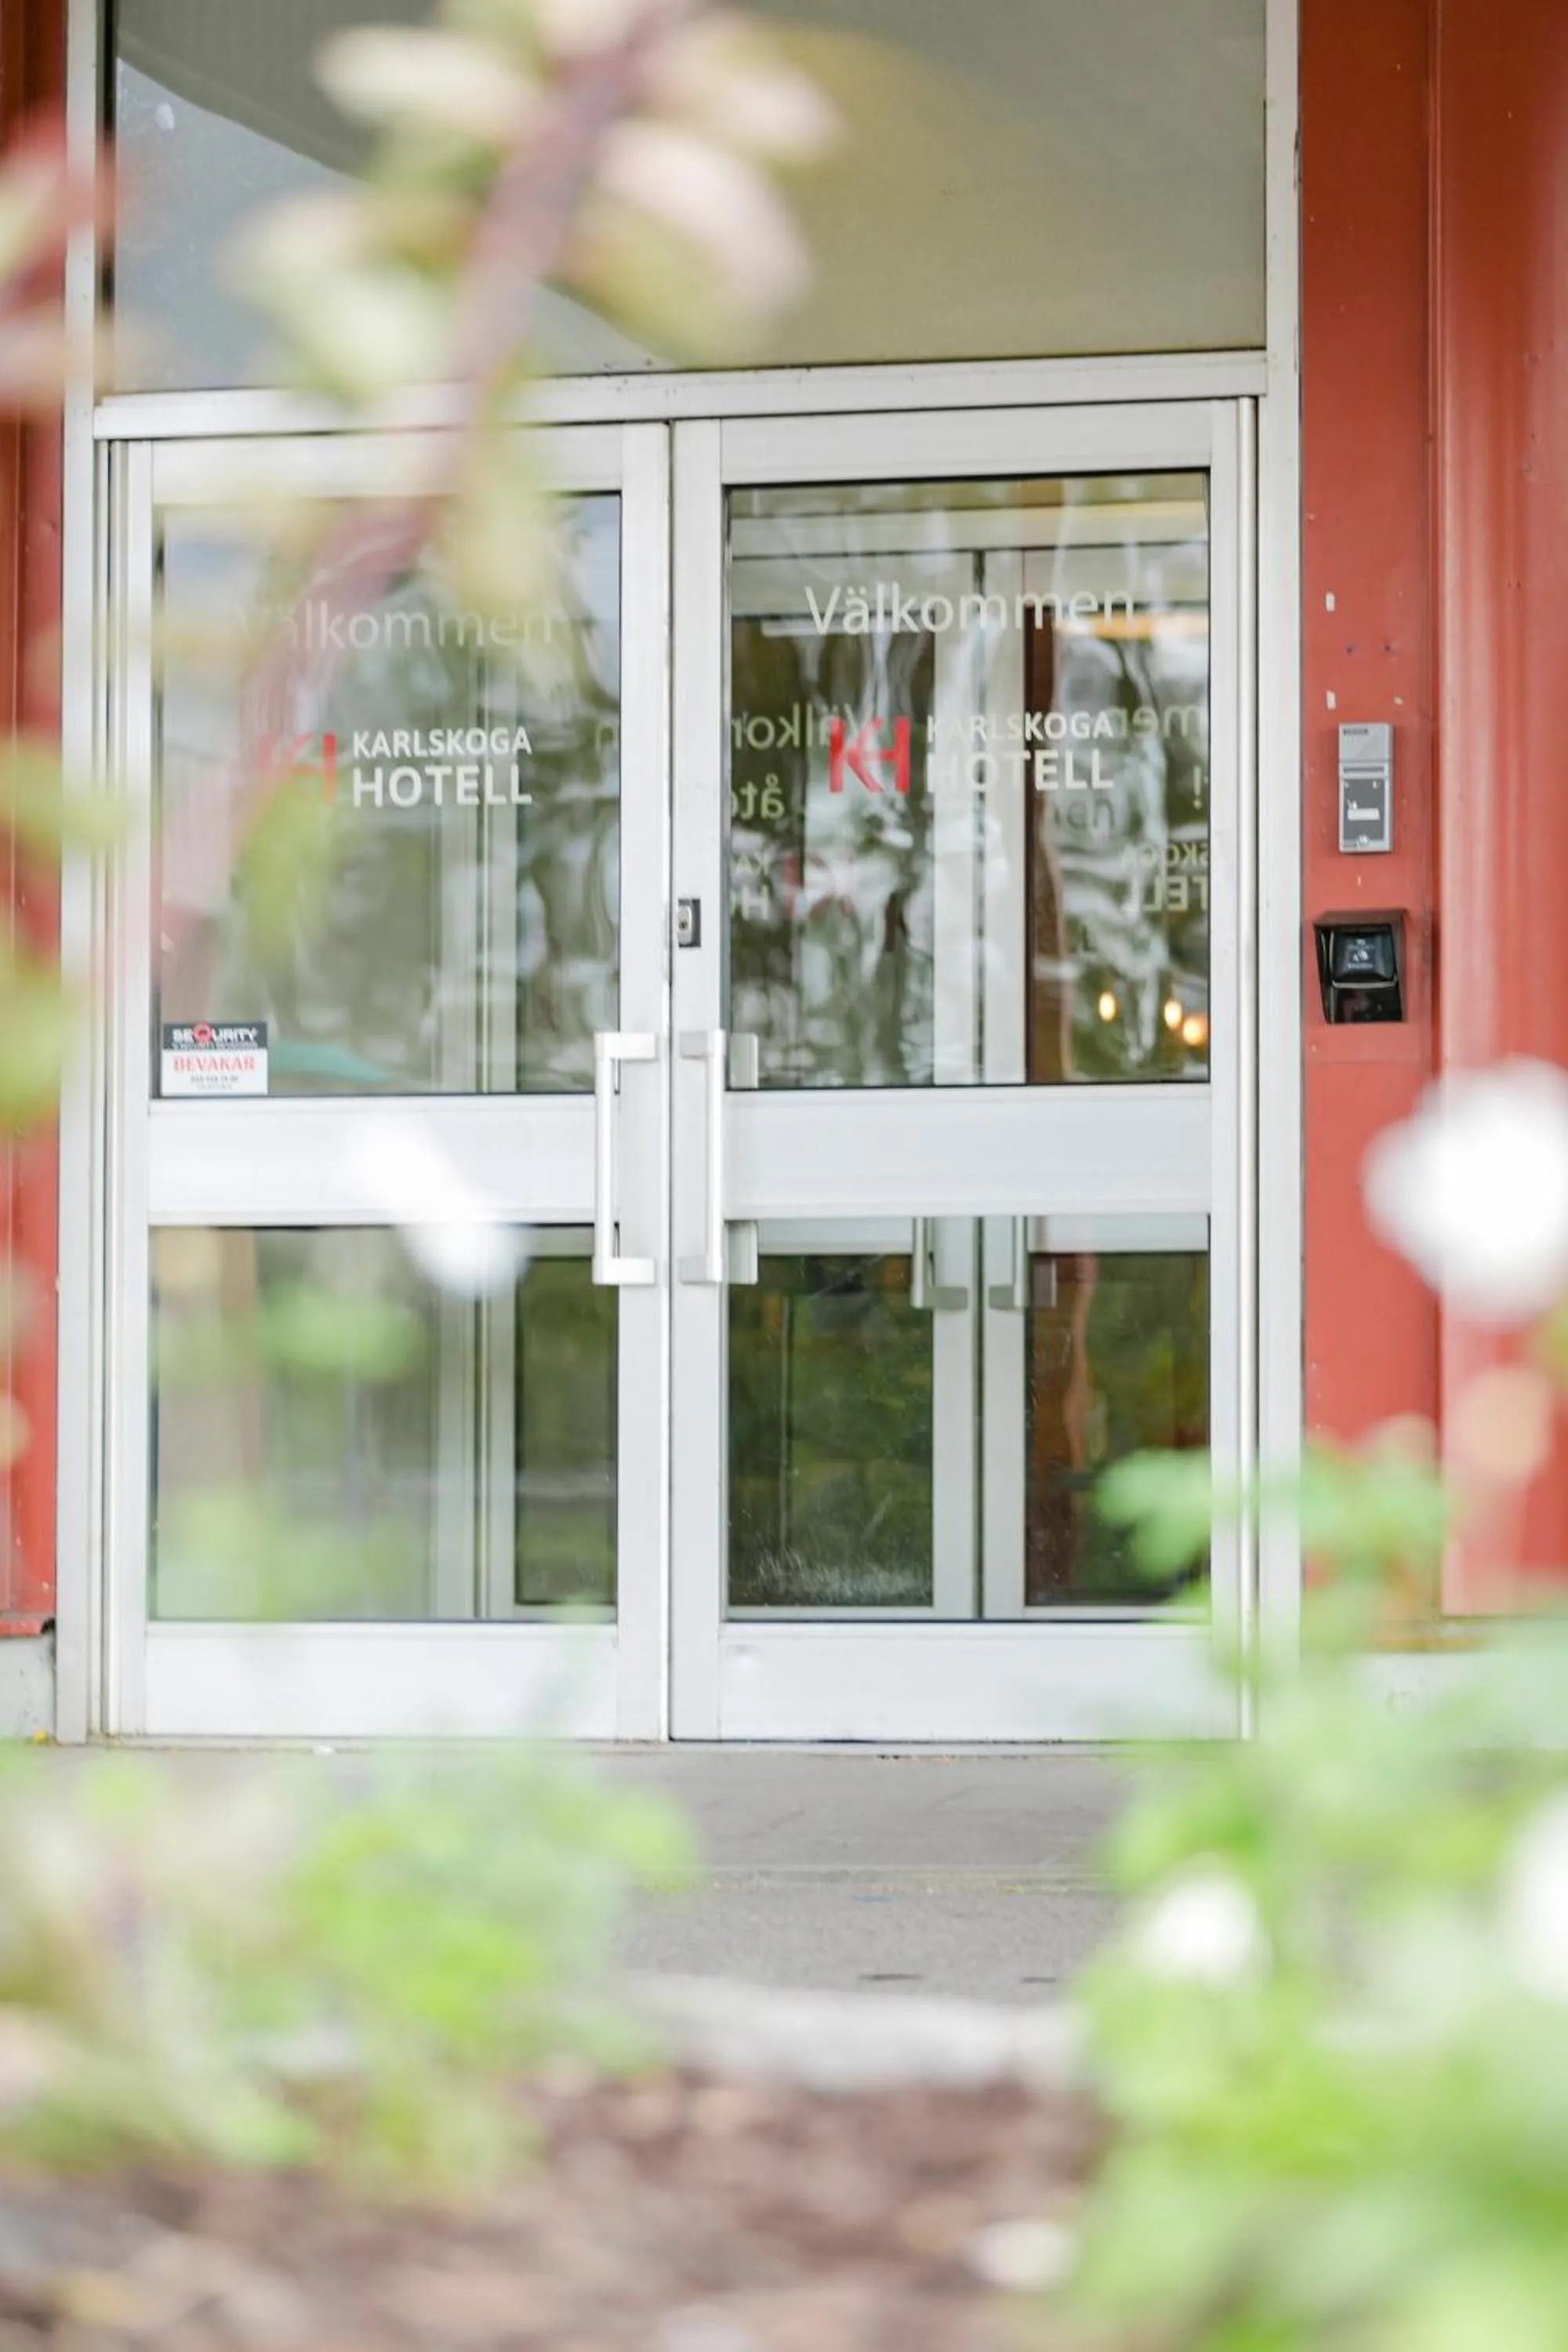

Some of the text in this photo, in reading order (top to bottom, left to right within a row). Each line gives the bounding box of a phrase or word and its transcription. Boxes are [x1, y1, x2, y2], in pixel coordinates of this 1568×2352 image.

[238, 600, 554, 648] lkommen
[804, 583, 1135, 635] Välkommen
[352, 726, 533, 759] KARLSKOGA
[927, 711, 1115, 743] KARLSKOGA
[351, 764, 533, 808] HOTELL
[927, 749, 1115, 793] HOTELL
